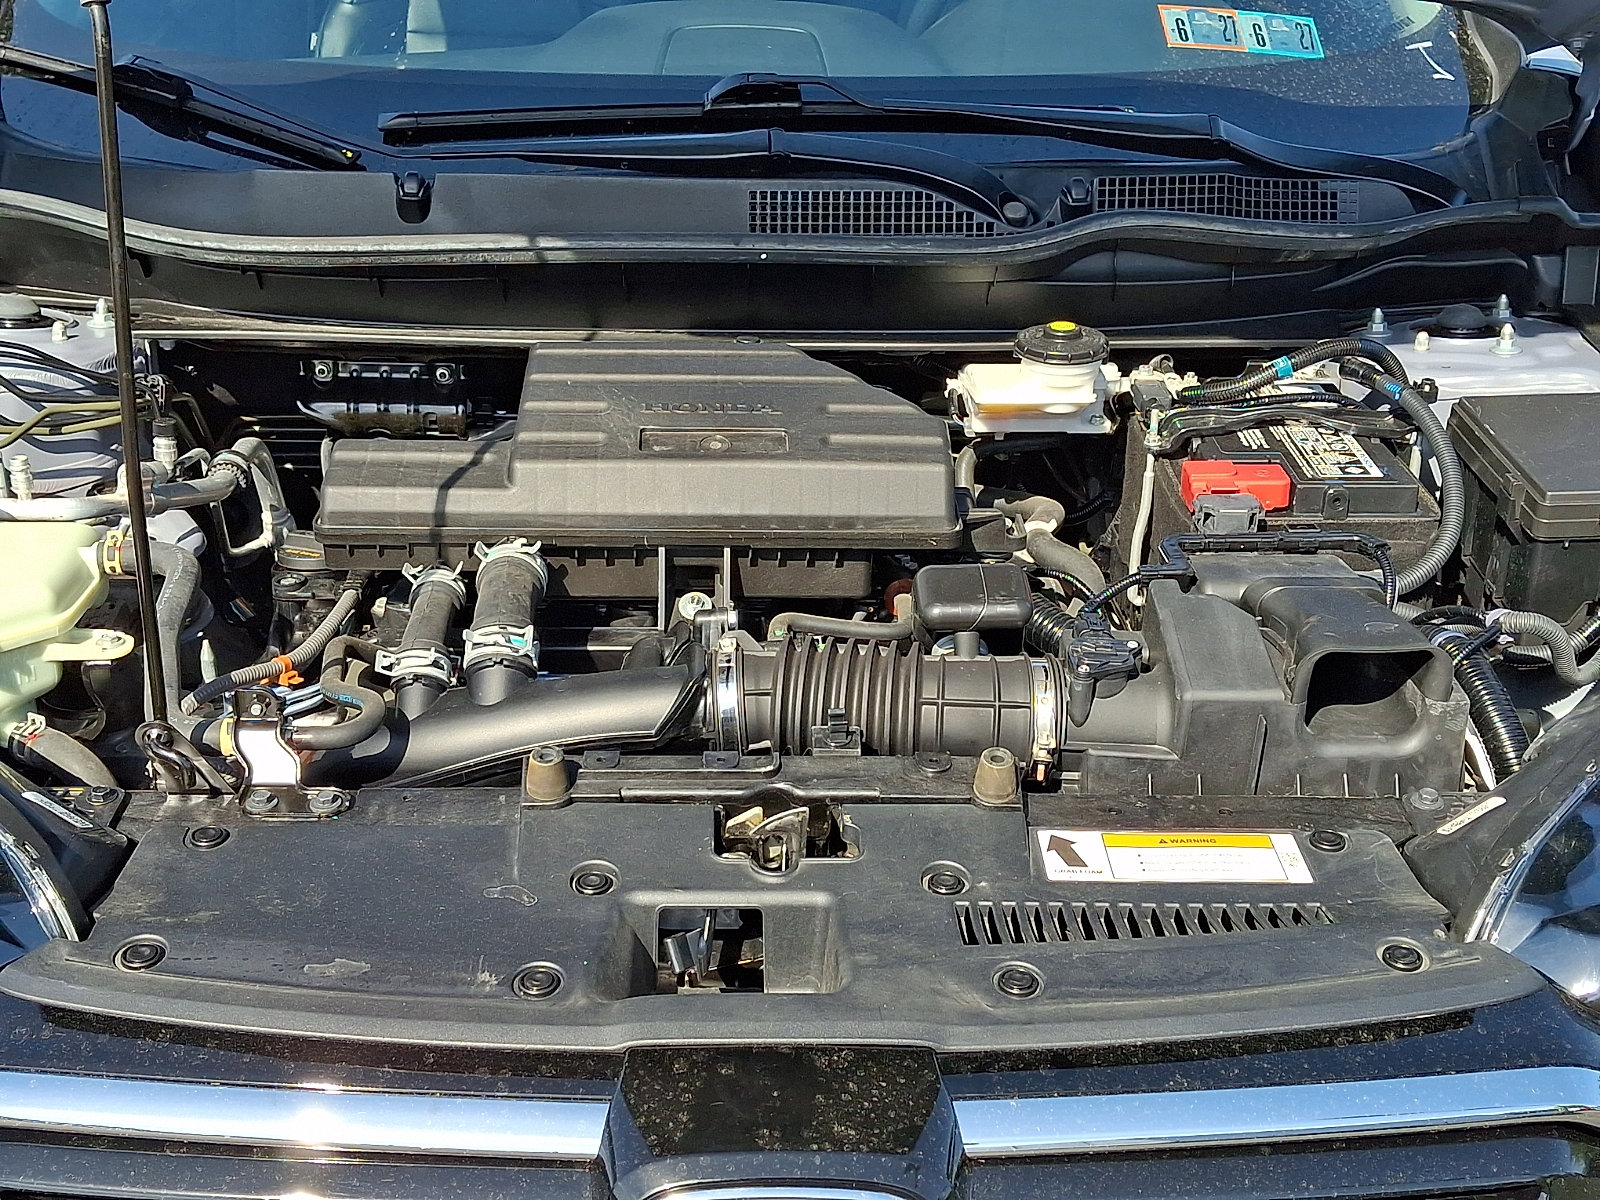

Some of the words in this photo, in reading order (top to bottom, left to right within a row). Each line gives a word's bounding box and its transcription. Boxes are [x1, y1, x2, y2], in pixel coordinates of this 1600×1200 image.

[1175, 17, 1190, 42] 6
[1218, 14, 1239, 43] 27
[1252, 23, 1267, 48] 6
[1295, 22, 1315, 51] 27
[640, 402, 784, 416] HONDA
